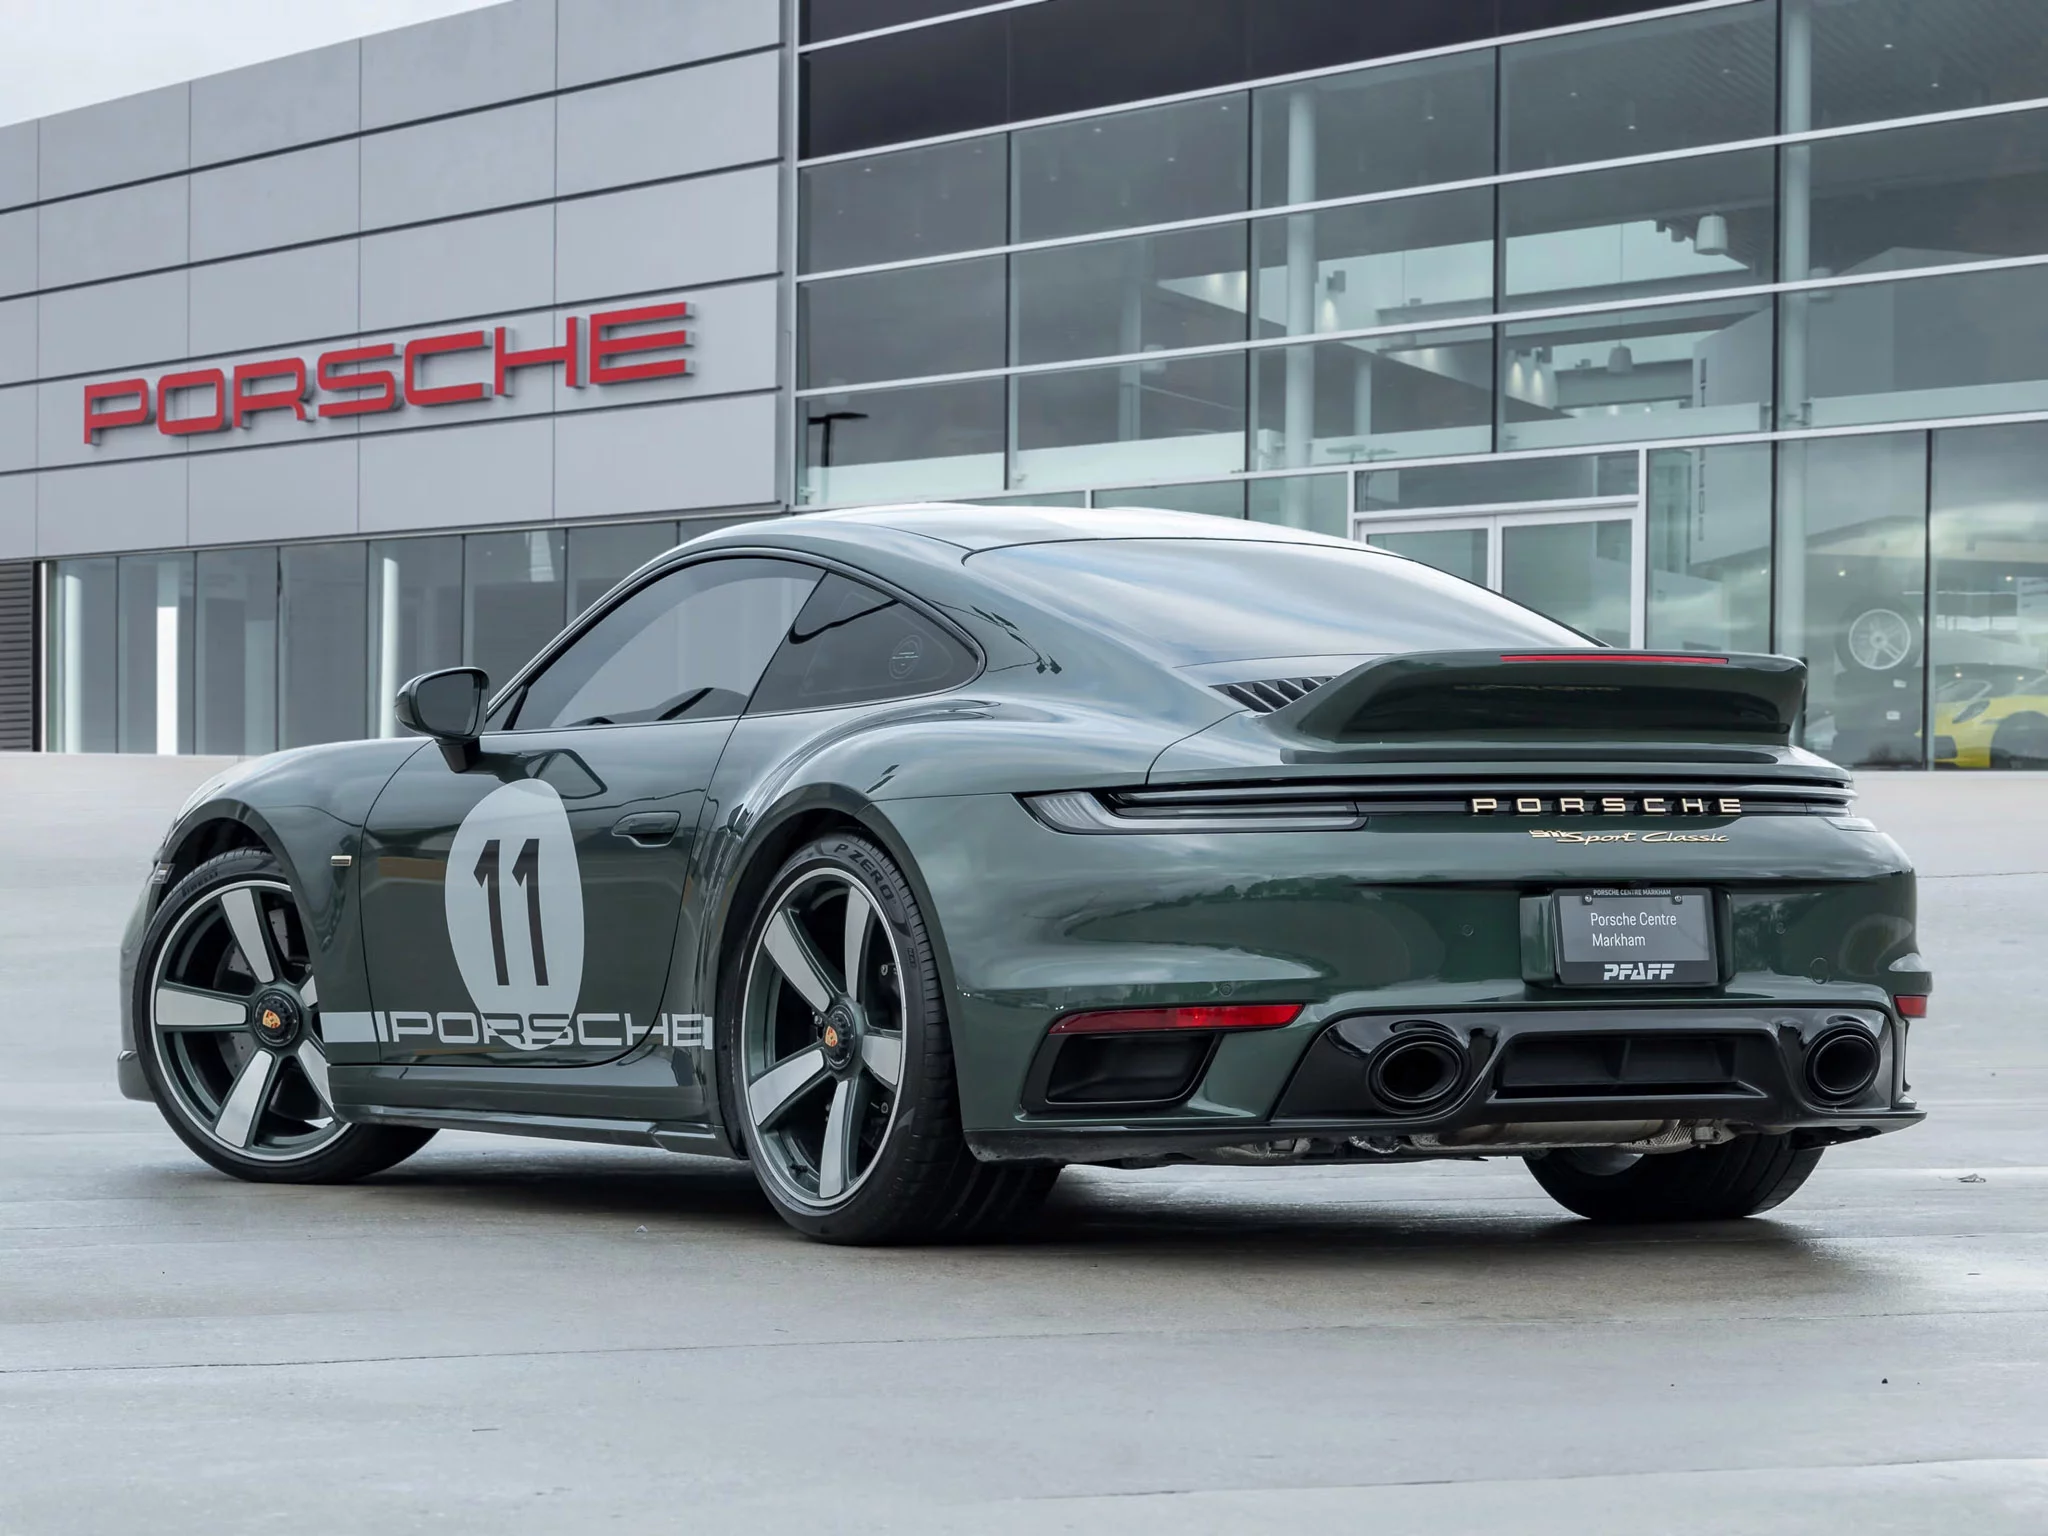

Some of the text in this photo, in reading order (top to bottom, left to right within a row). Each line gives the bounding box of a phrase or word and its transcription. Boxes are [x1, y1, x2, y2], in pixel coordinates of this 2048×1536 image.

[84, 301, 690, 446] PORSCHE
[1471, 797, 1742, 814] PORSCHE
[1556, 832, 1637, 846] Sport
[1641, 831, 1730, 843] Classic
[848, 849, 895, 901] ZERO
[473, 838, 550, 987] 11
[1590, 911, 1677, 927] Porsche Centre
[1592, 933, 1646, 947] Markham
[1604, 962, 1676, 981] PFAFF
[389, 1011, 702, 1047] PORSCHE
